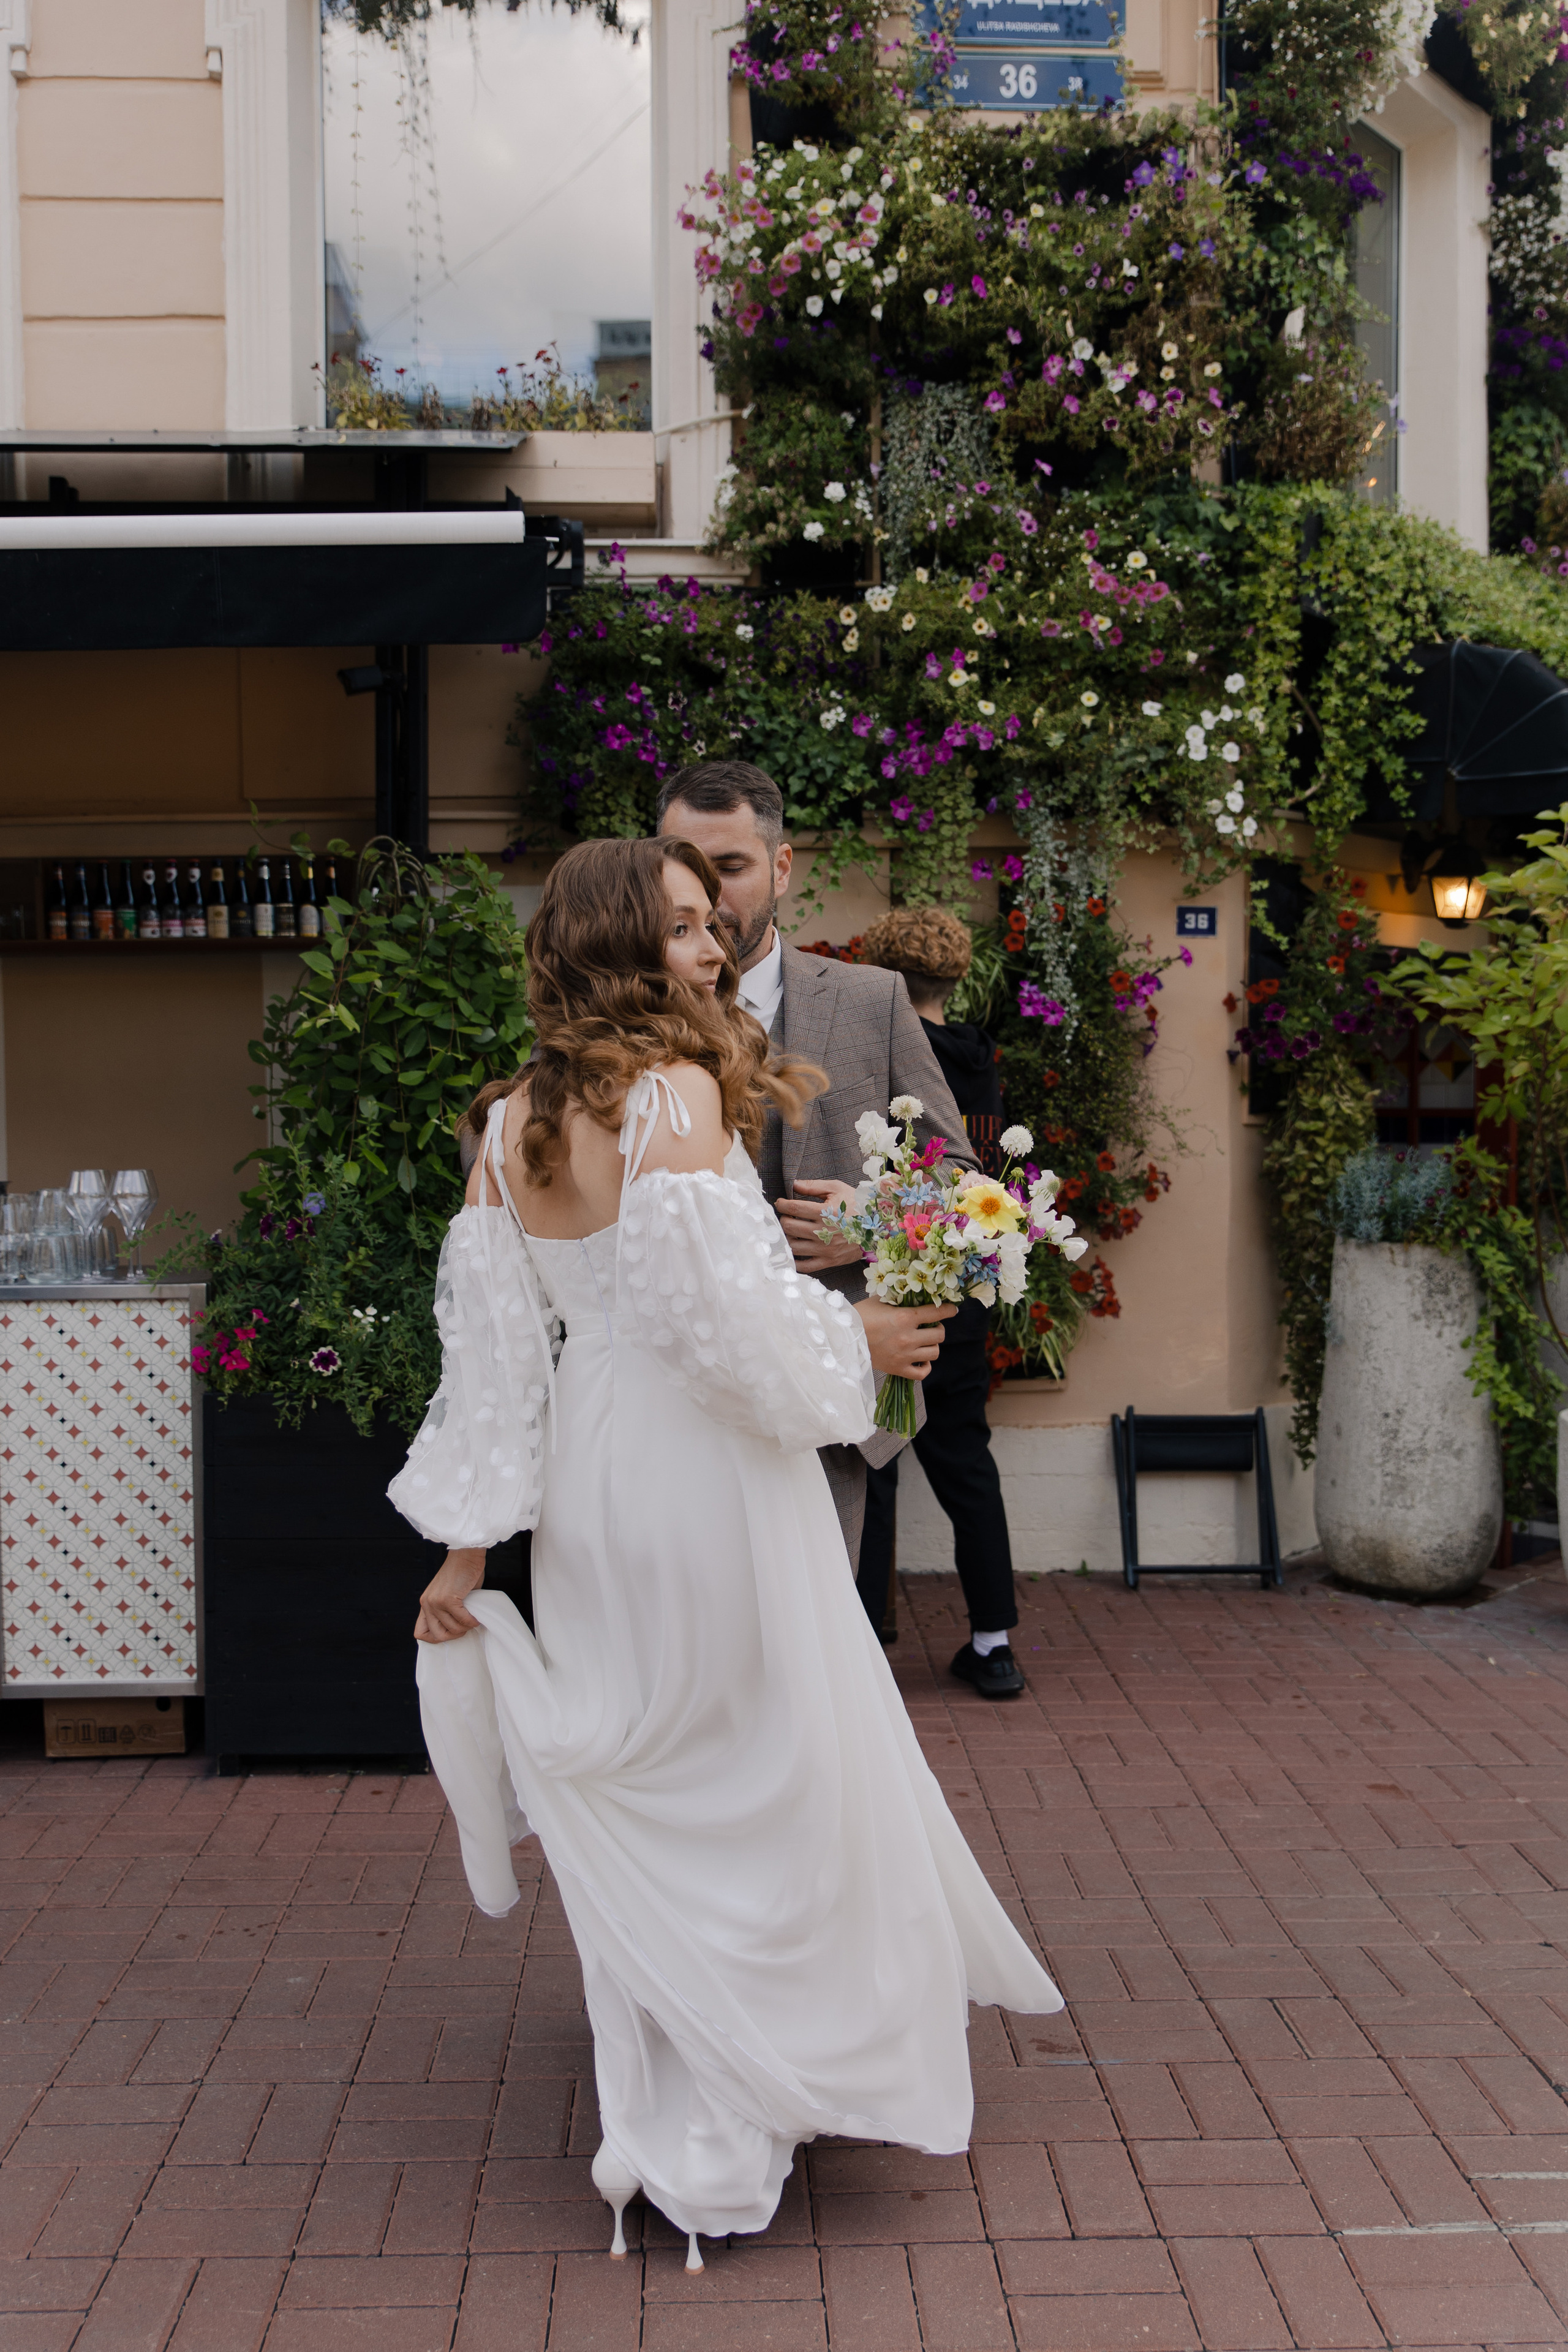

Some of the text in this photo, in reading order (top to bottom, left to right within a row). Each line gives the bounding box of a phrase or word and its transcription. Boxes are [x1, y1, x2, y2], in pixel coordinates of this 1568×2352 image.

[976, 21, 1004, 31] ULITSA
[953, 64, 1083, 99] 34 36 38
[1185, 913, 1208, 929] 36
